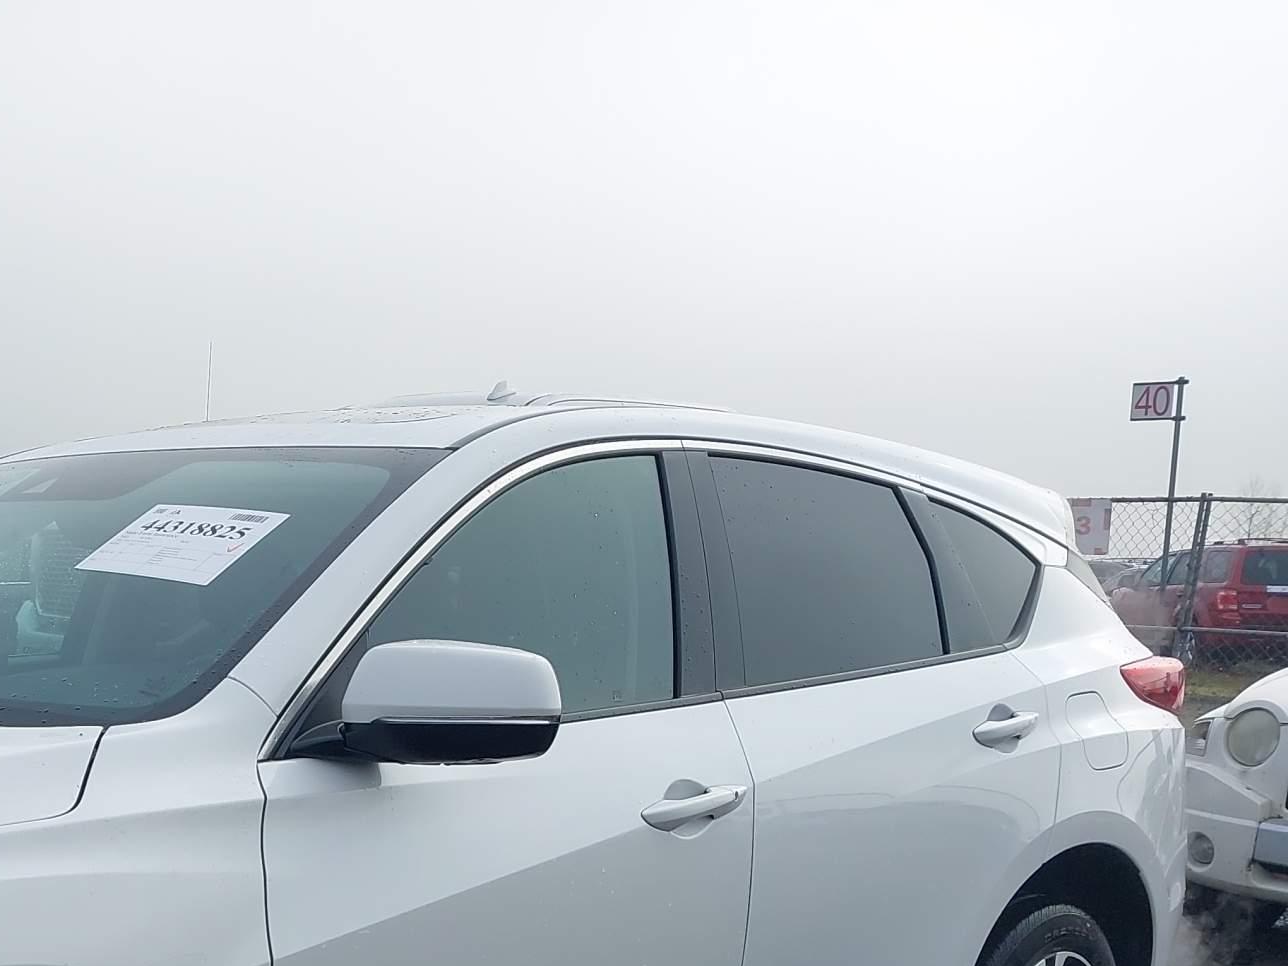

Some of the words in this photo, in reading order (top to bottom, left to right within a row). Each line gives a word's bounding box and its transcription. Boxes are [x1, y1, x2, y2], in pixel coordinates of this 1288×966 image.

[1134, 385, 1171, 417] 40
[141, 519, 252, 540] 44318825
[1075, 515, 1091, 535] 3
